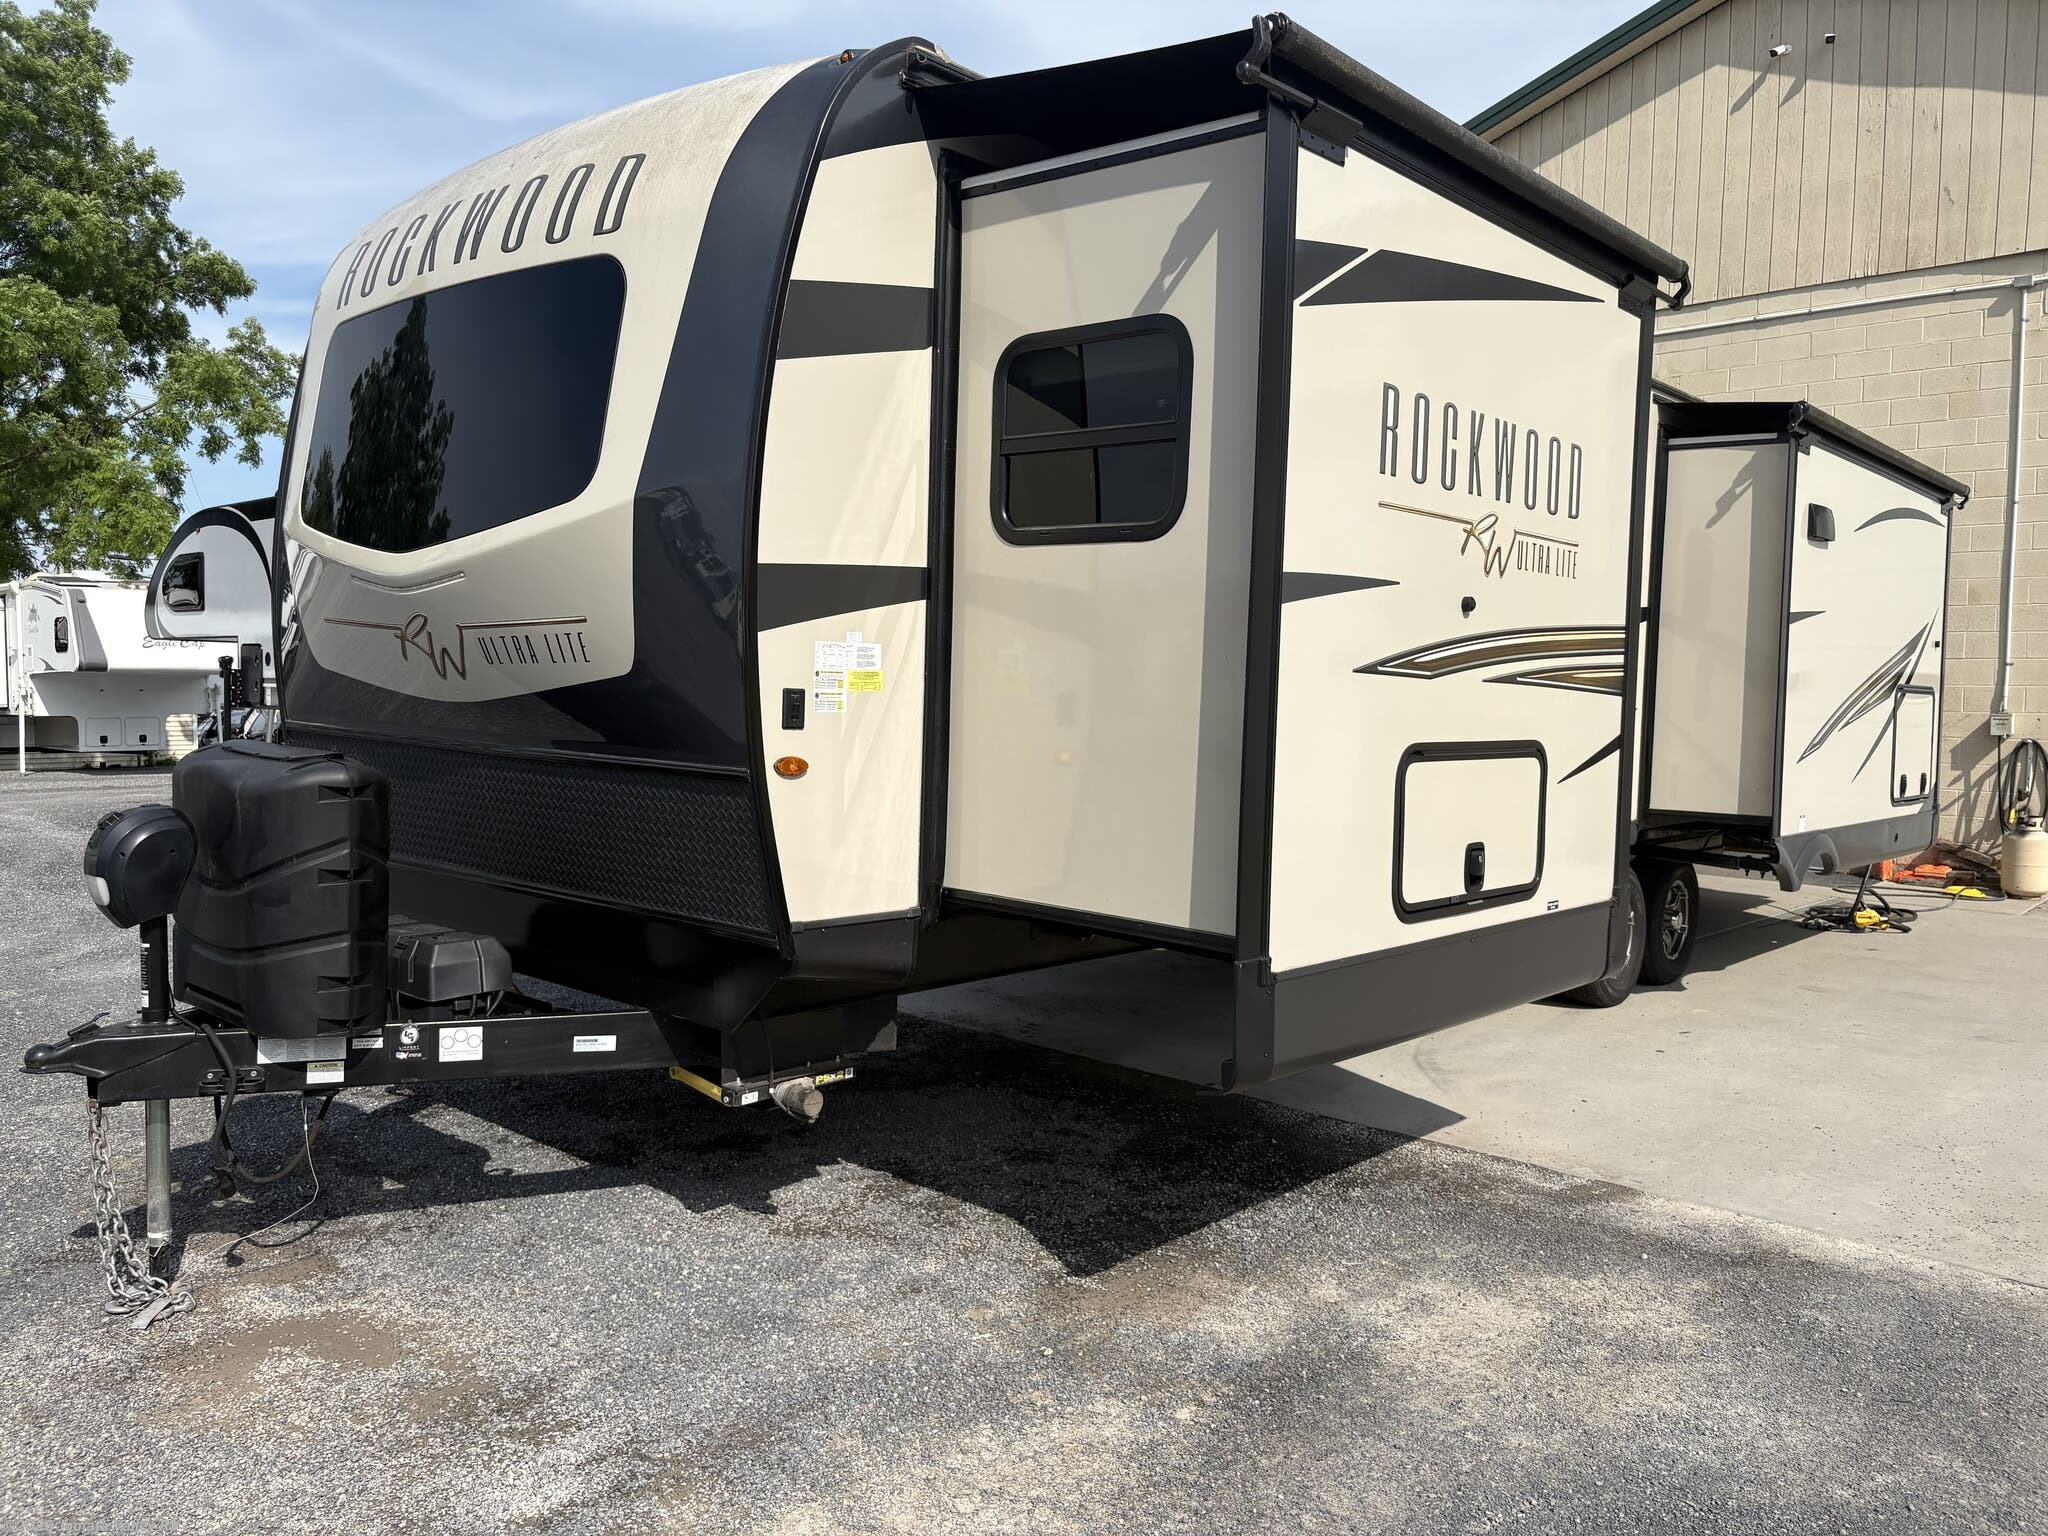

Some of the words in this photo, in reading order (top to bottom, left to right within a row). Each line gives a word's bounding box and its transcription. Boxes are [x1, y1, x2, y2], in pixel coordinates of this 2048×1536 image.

[336, 153, 647, 310] ROCKWOOD
[1379, 381, 1583, 520] ROCKWOOD
[1516, 539, 1550, 575] ULTRA
[1555, 547, 1578, 580] LITE
[477, 635, 540, 665] ULTRA
[543, 632, 591, 664] LITE
